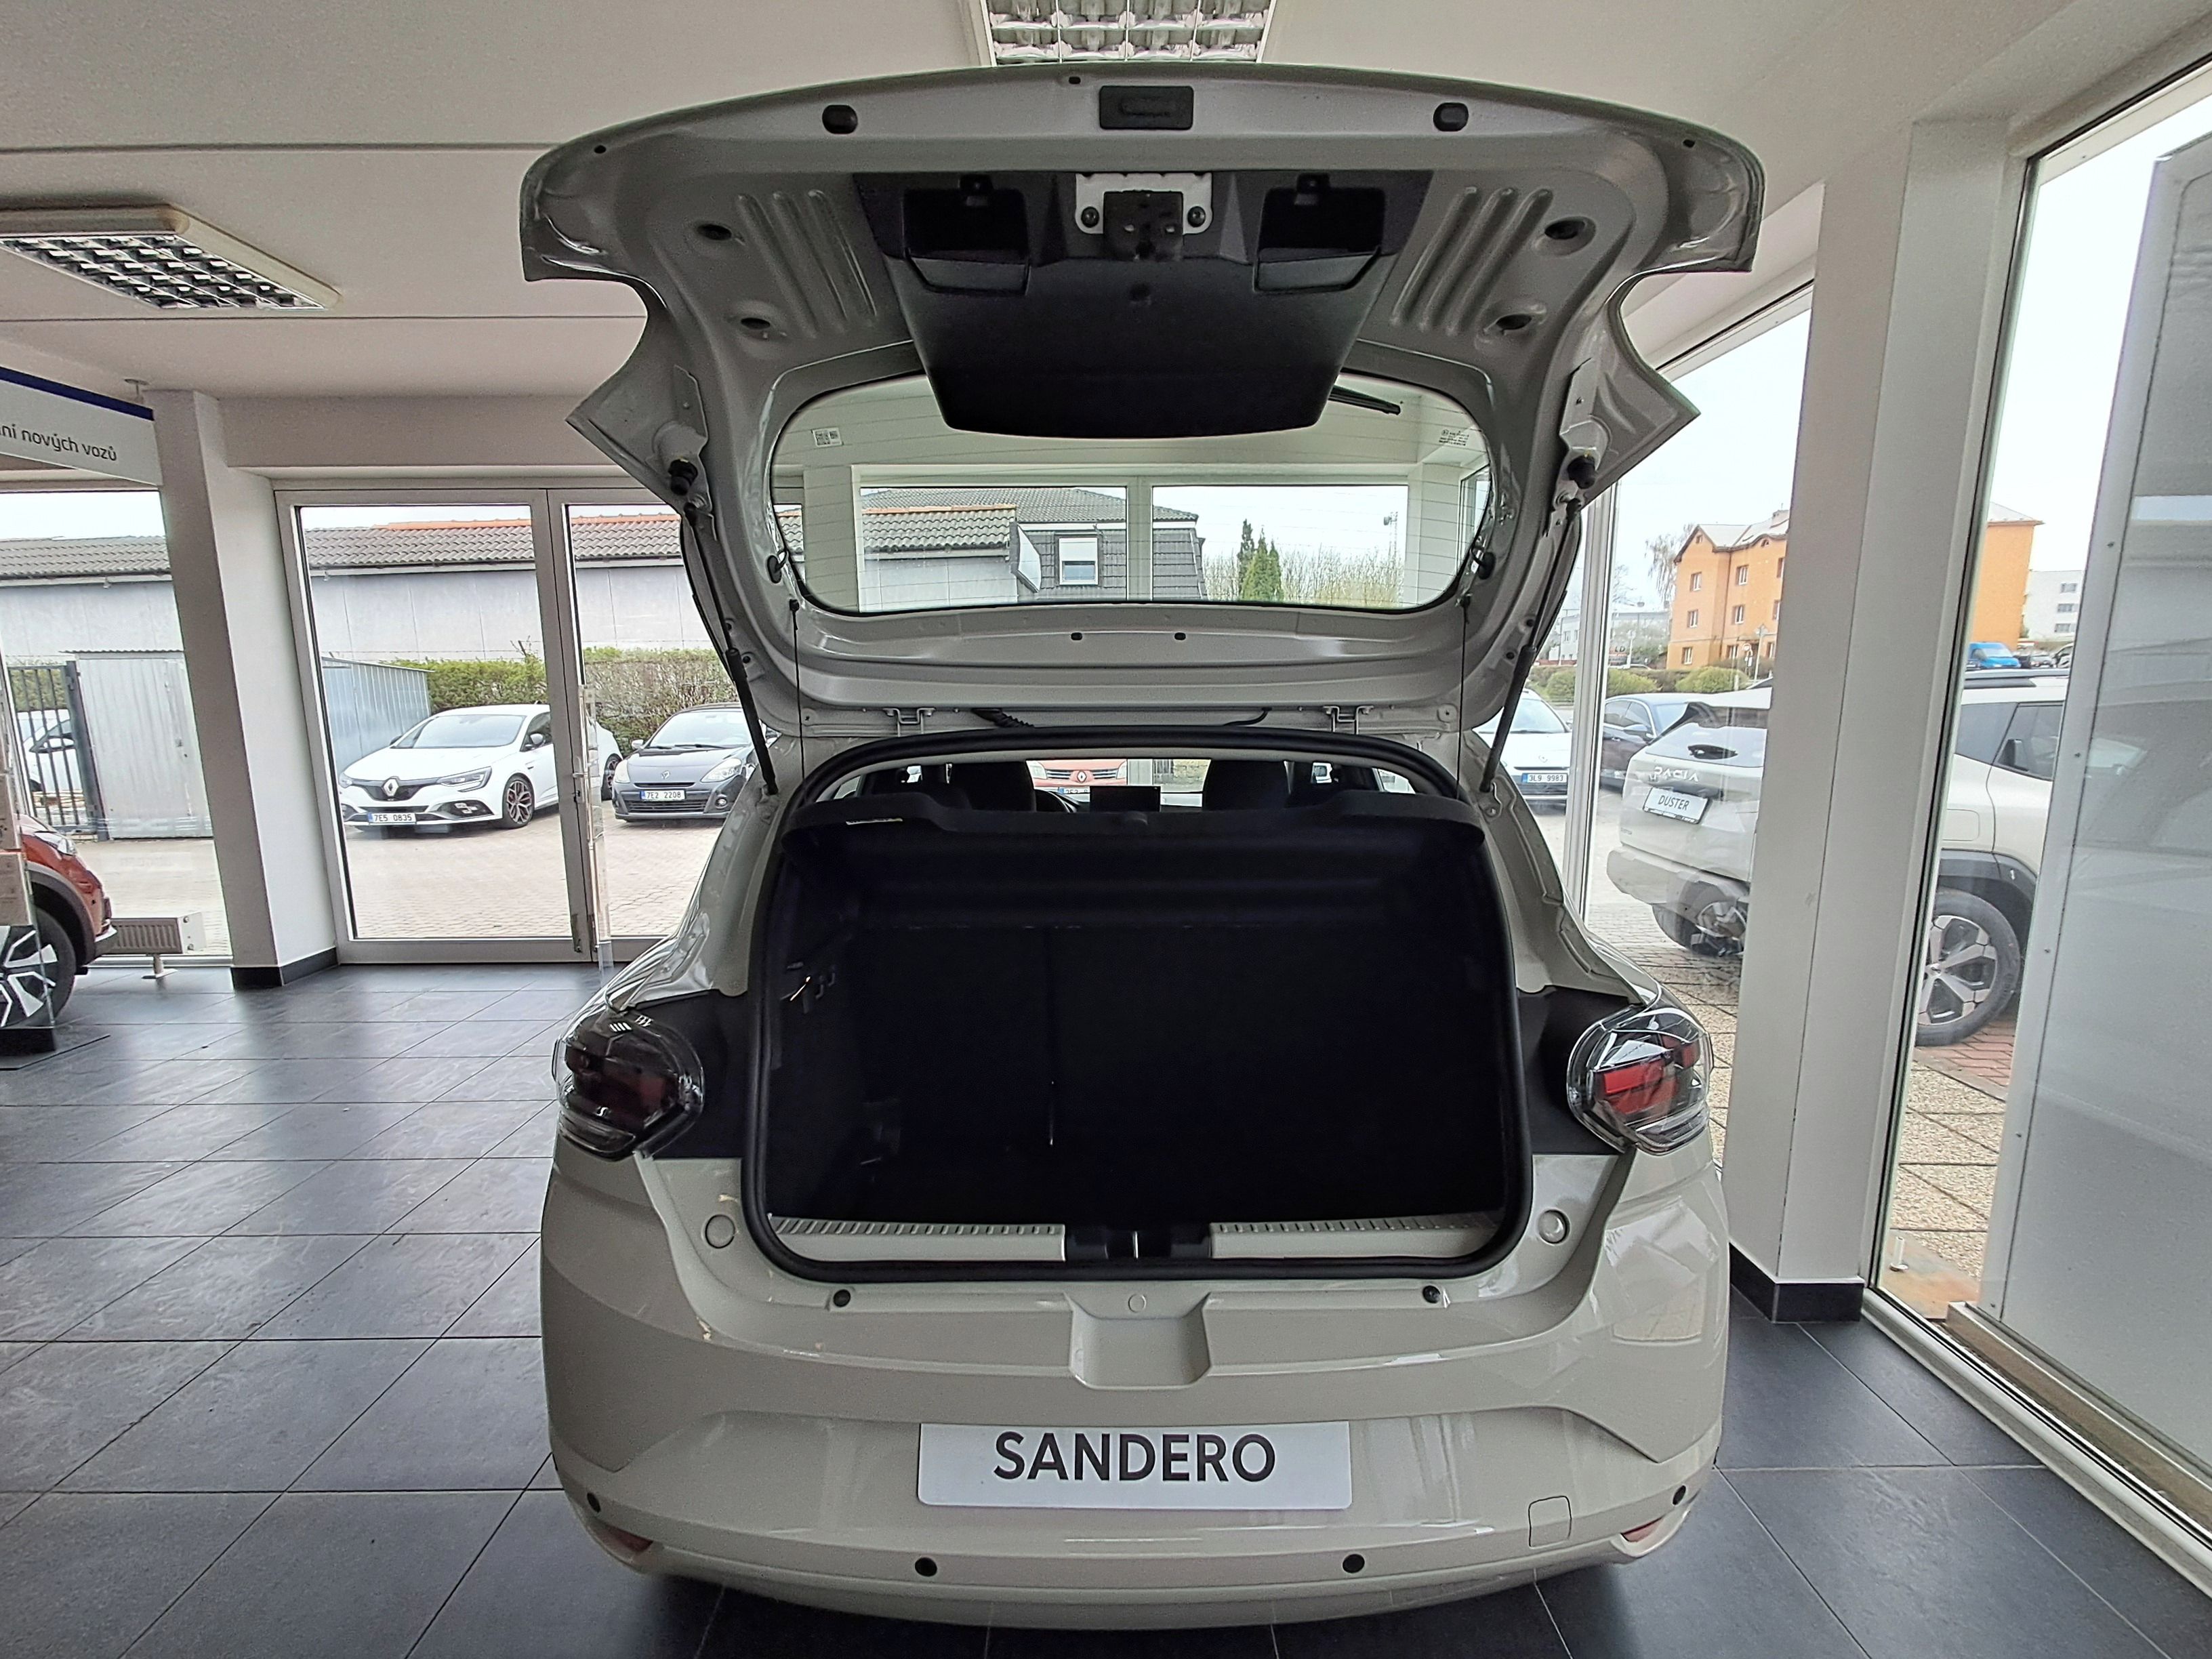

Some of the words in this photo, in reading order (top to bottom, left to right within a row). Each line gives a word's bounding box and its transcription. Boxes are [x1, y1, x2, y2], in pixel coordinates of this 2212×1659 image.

[0, 424, 17, 439] ní
[22, 430, 79, 452] nových
[82, 443, 117, 461] vozů
[1658, 795, 1689, 811] DUSTER
[994, 1431, 1275, 1482] SANDERO
